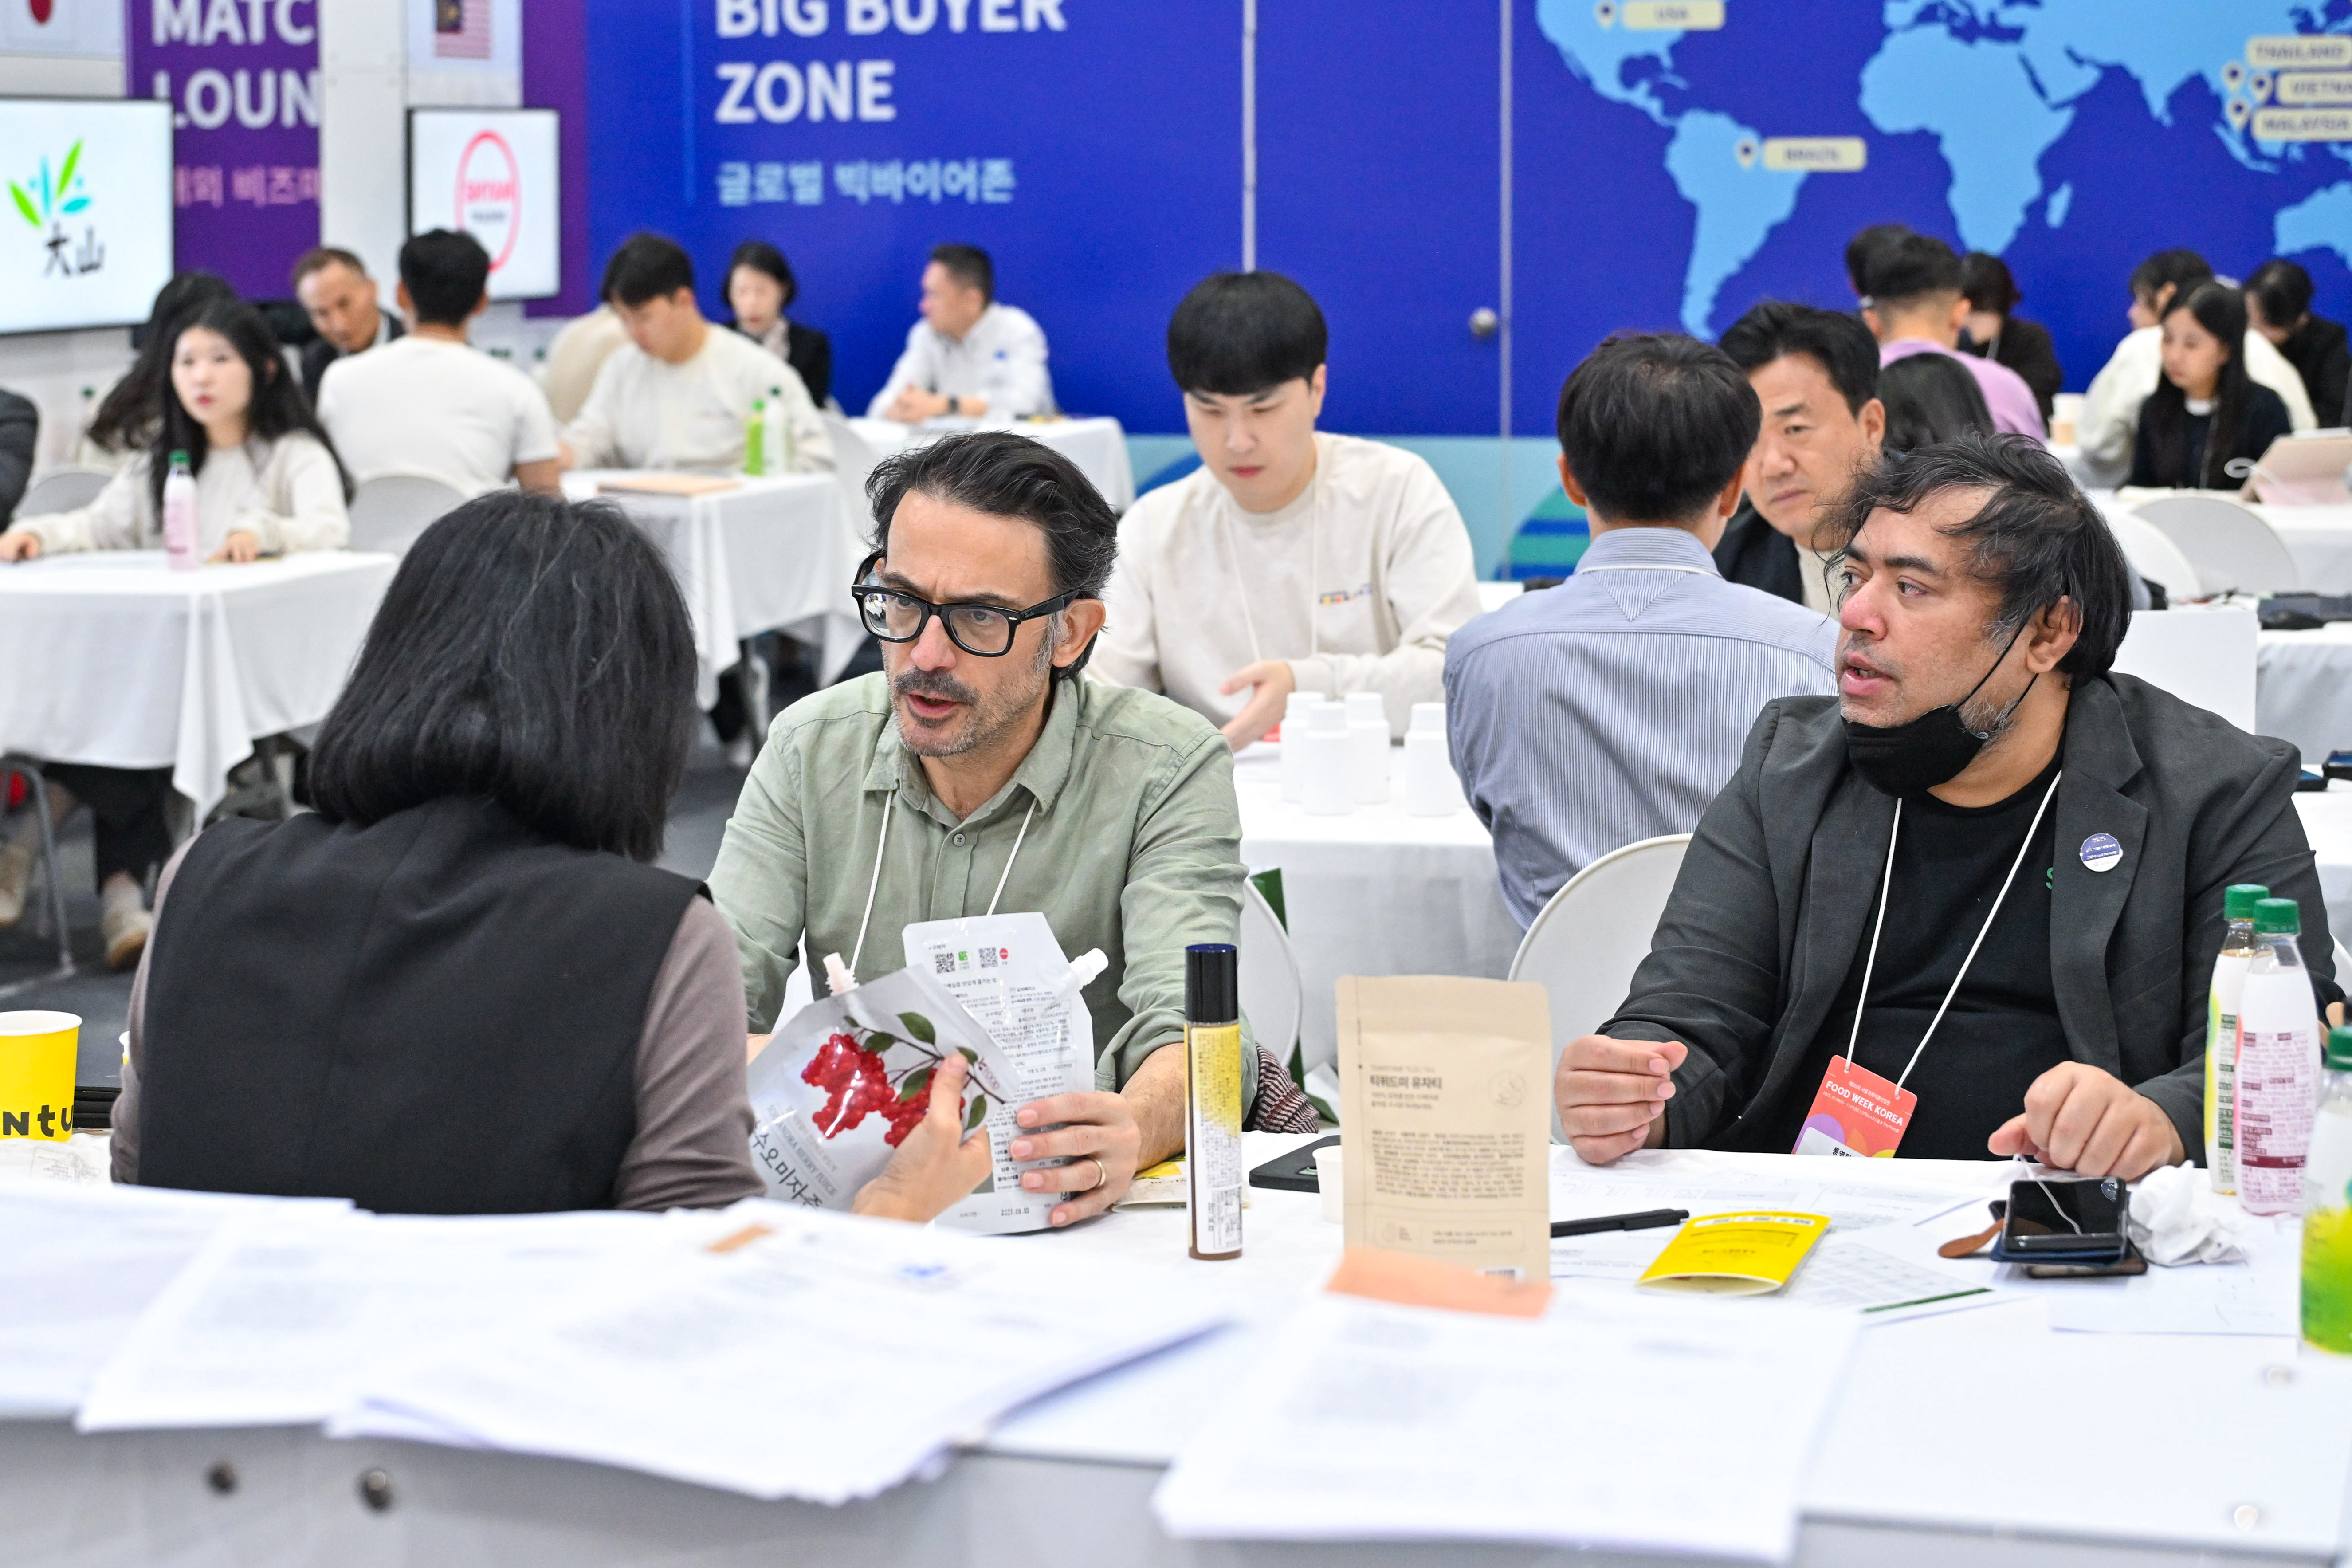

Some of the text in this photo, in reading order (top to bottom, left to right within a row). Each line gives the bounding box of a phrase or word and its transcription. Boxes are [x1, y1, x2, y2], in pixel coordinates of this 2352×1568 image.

[716, 0, 1068, 37] BIG BUYER
[715, 59, 896, 124] ZONE
[717, 157, 1015, 207] 글로벌 빅바이어존
[767, 1104, 798, 1147] SCHANDRA
[1826, 1081, 1903, 1126] FOOD WEEK KOREA
[753, 1120, 823, 1206] 수오미자
[1832, 1147, 1851, 1157] 통역
